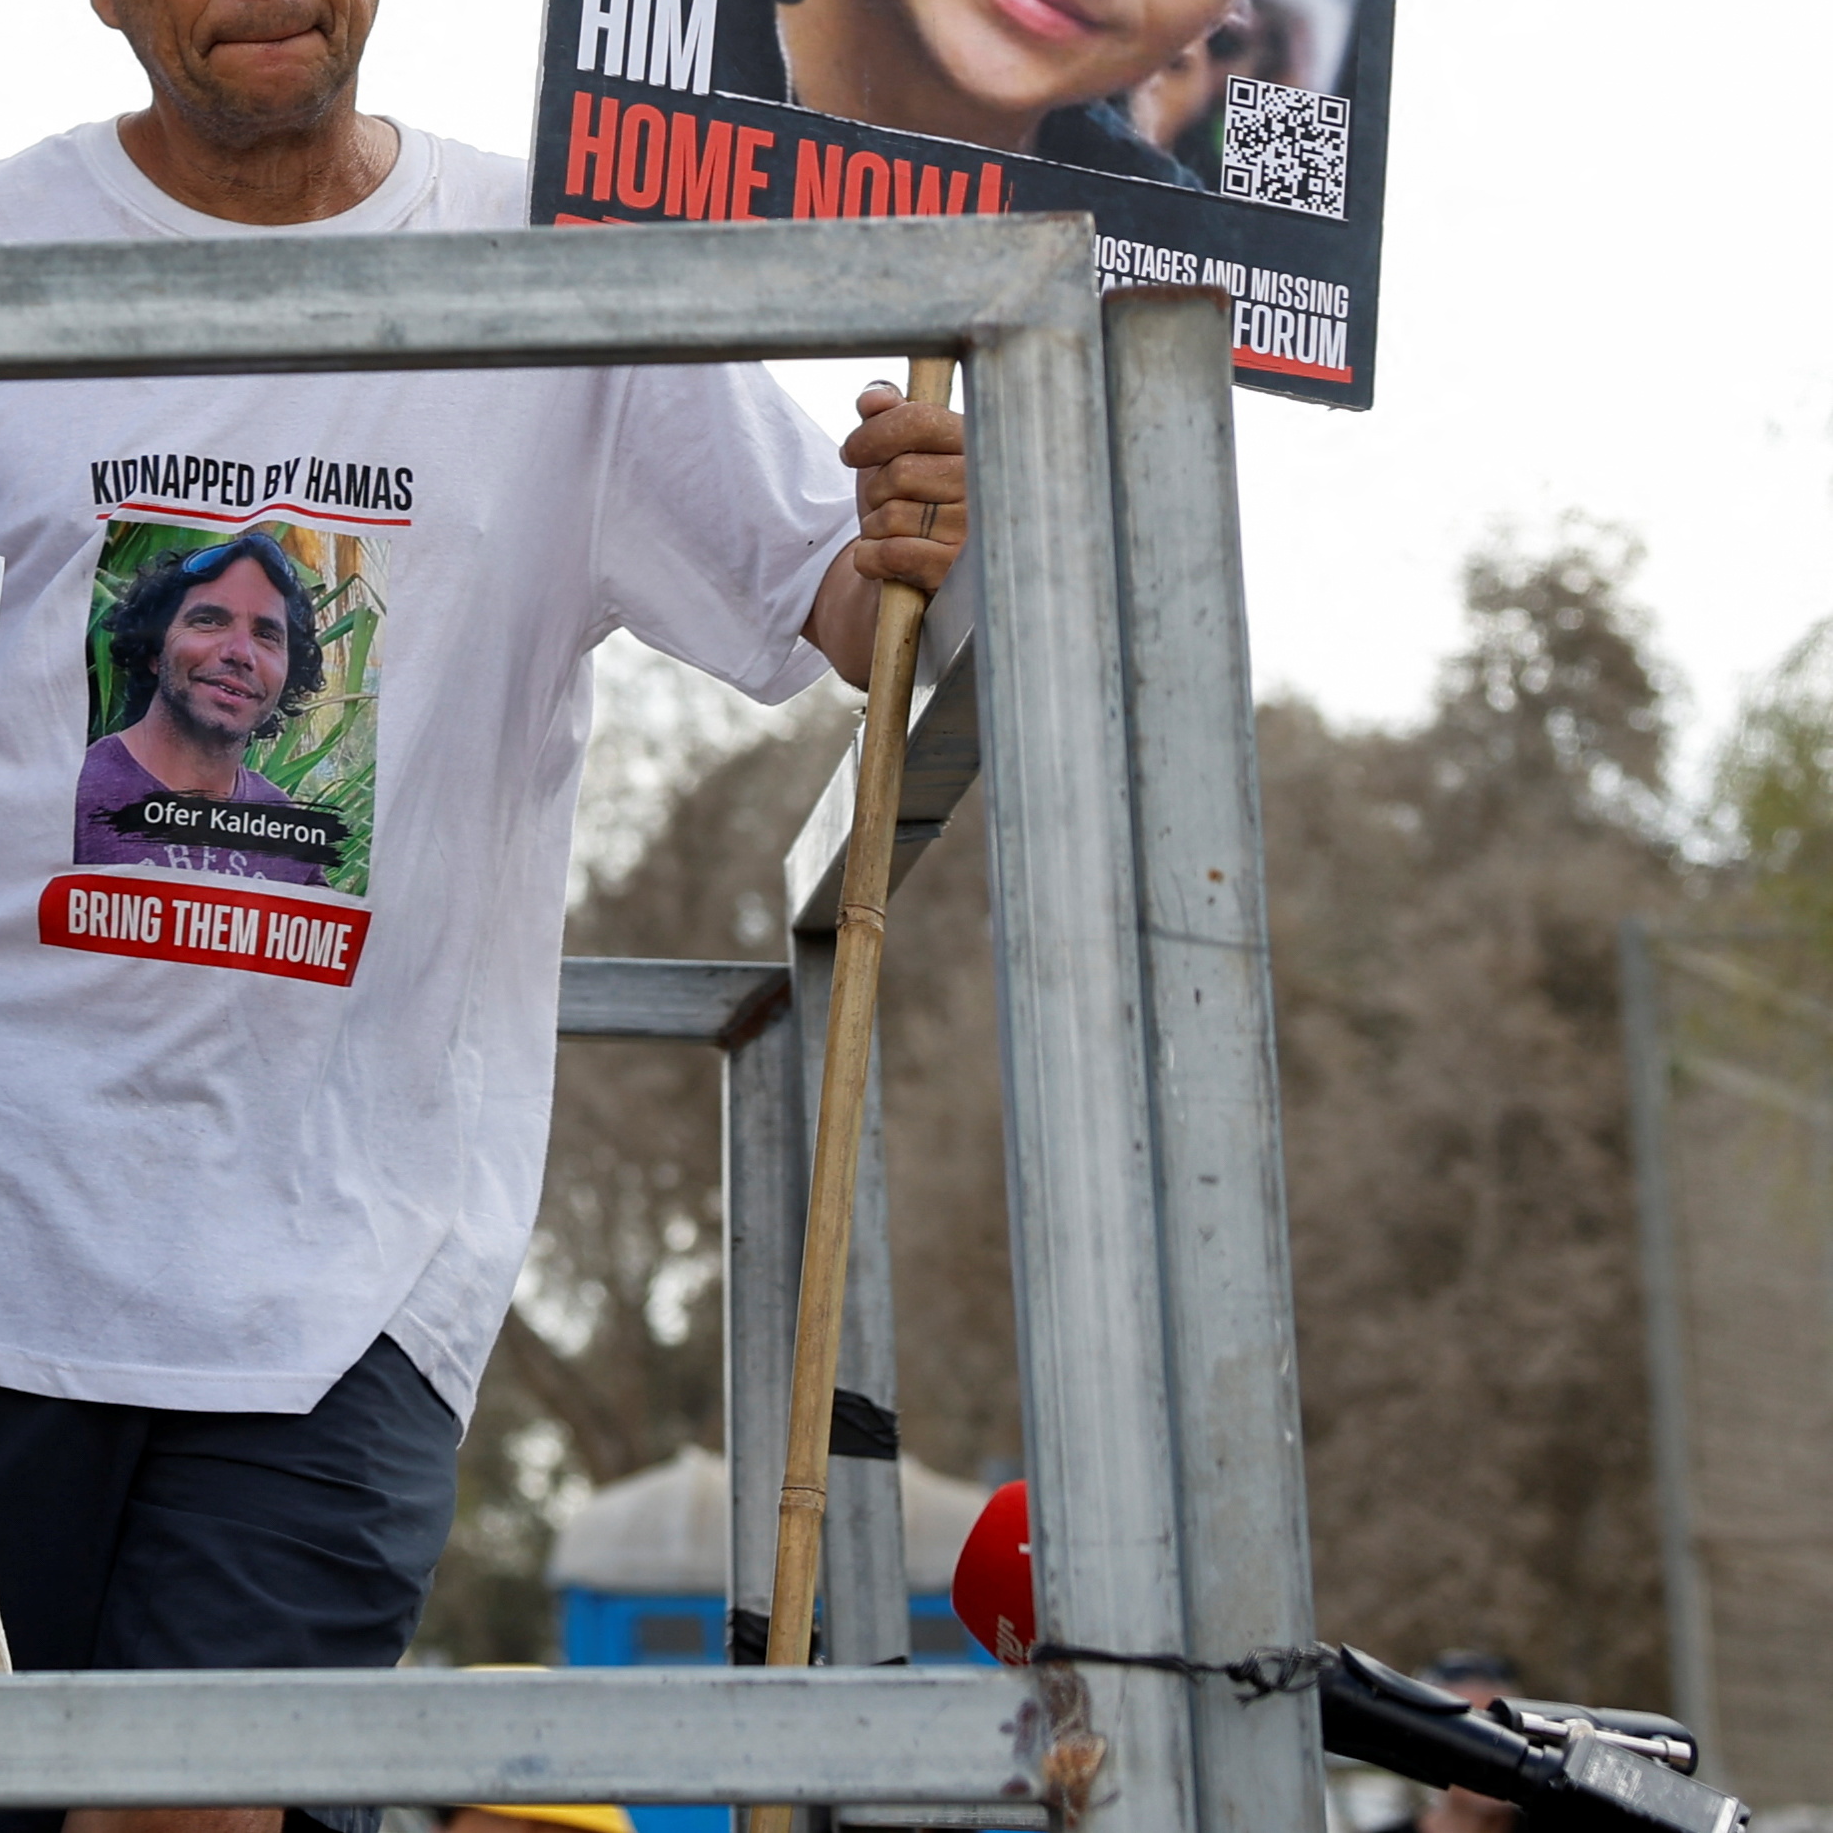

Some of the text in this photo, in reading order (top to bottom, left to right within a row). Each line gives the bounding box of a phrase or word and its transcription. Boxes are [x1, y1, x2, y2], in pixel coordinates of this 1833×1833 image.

[565, 91, 775, 222] HOME
[1202, 258, 1246, 297] AND
[1250, 267, 1349, 318] MISSING
[1233, 300, 1348, 370] FORUM
[90, 454, 413, 512] KIDNAPPED BY HAMAS
[144, 801, 327, 846] Ofer Kalderon
[67, 887, 352, 971] BRING THEM HOME
